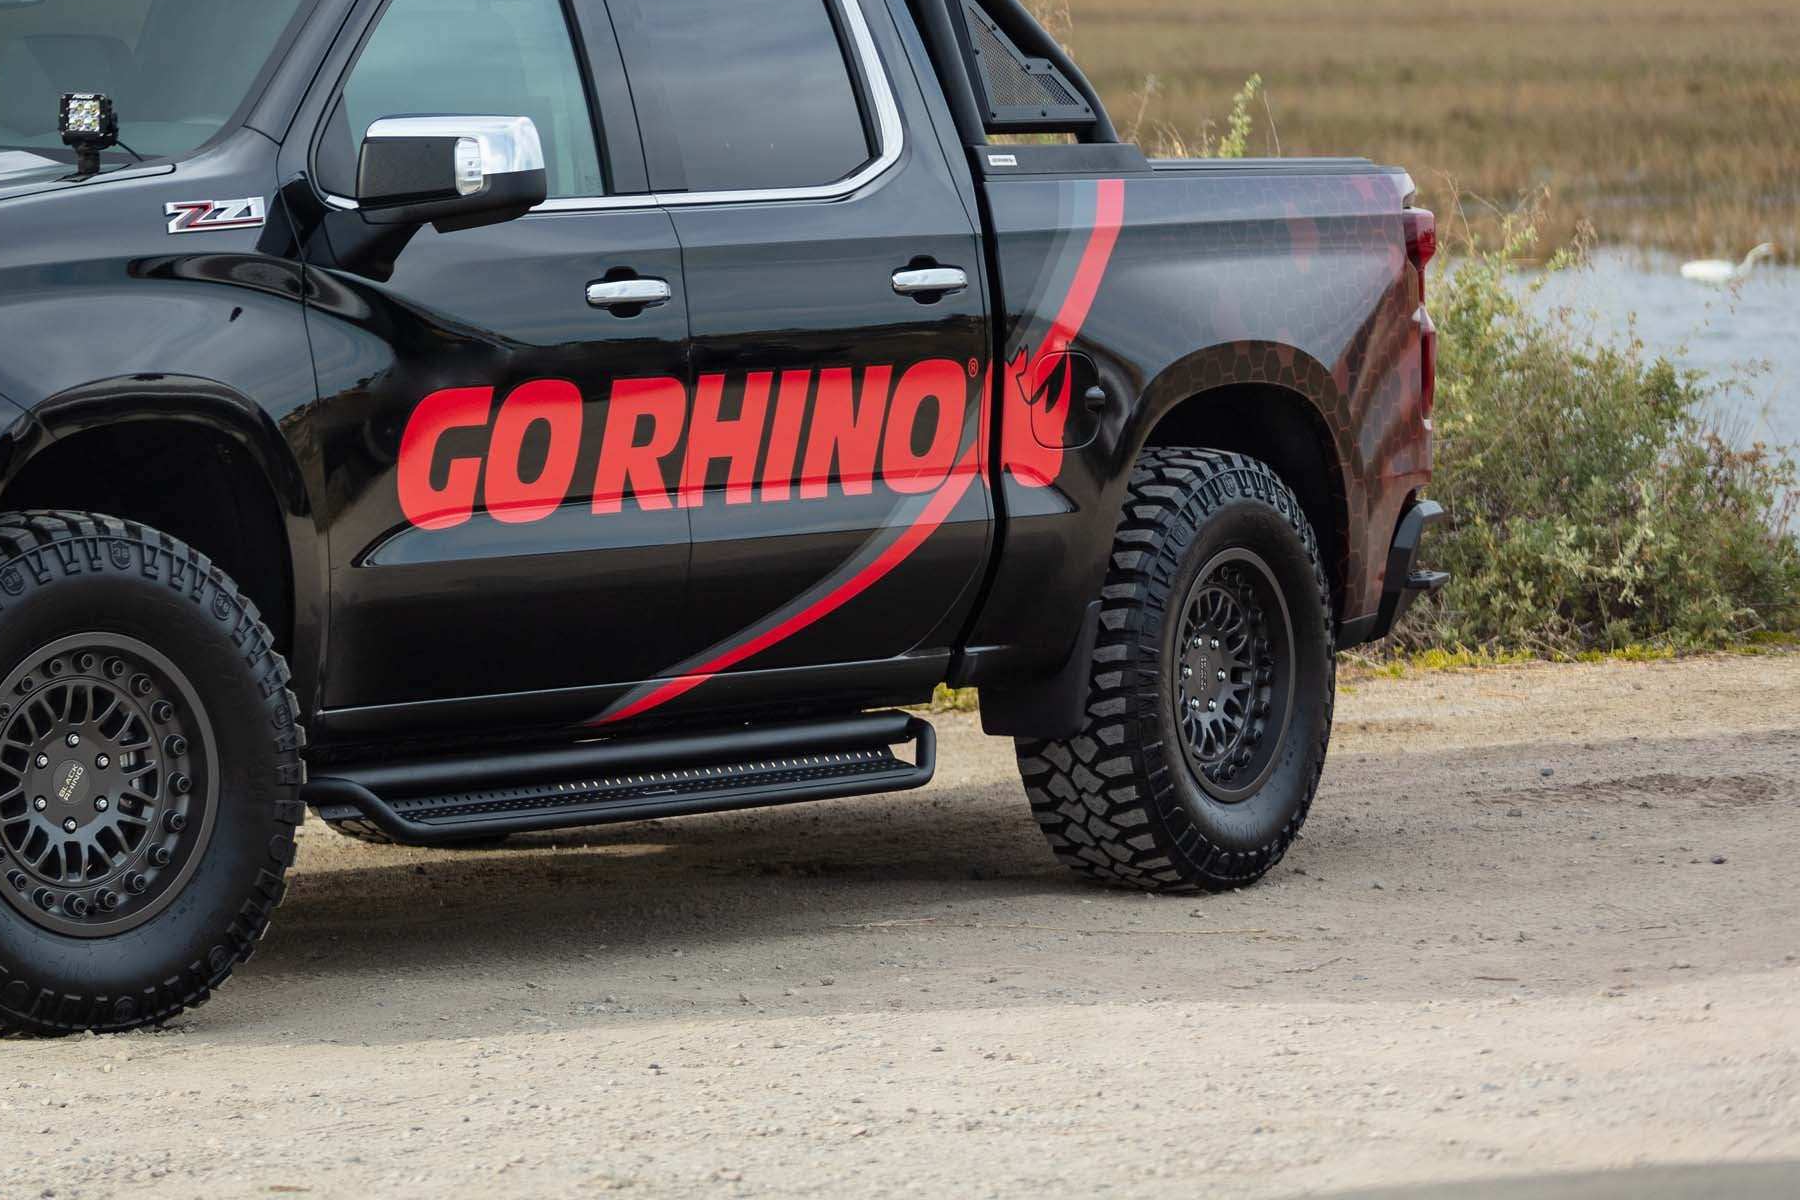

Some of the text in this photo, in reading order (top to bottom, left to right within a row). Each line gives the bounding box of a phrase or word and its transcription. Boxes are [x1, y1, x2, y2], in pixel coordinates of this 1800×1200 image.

[397, 358, 967, 530] GO RHINO
[58, 761, 78, 798] BLACK
[63, 766, 84, 801] RHINO
